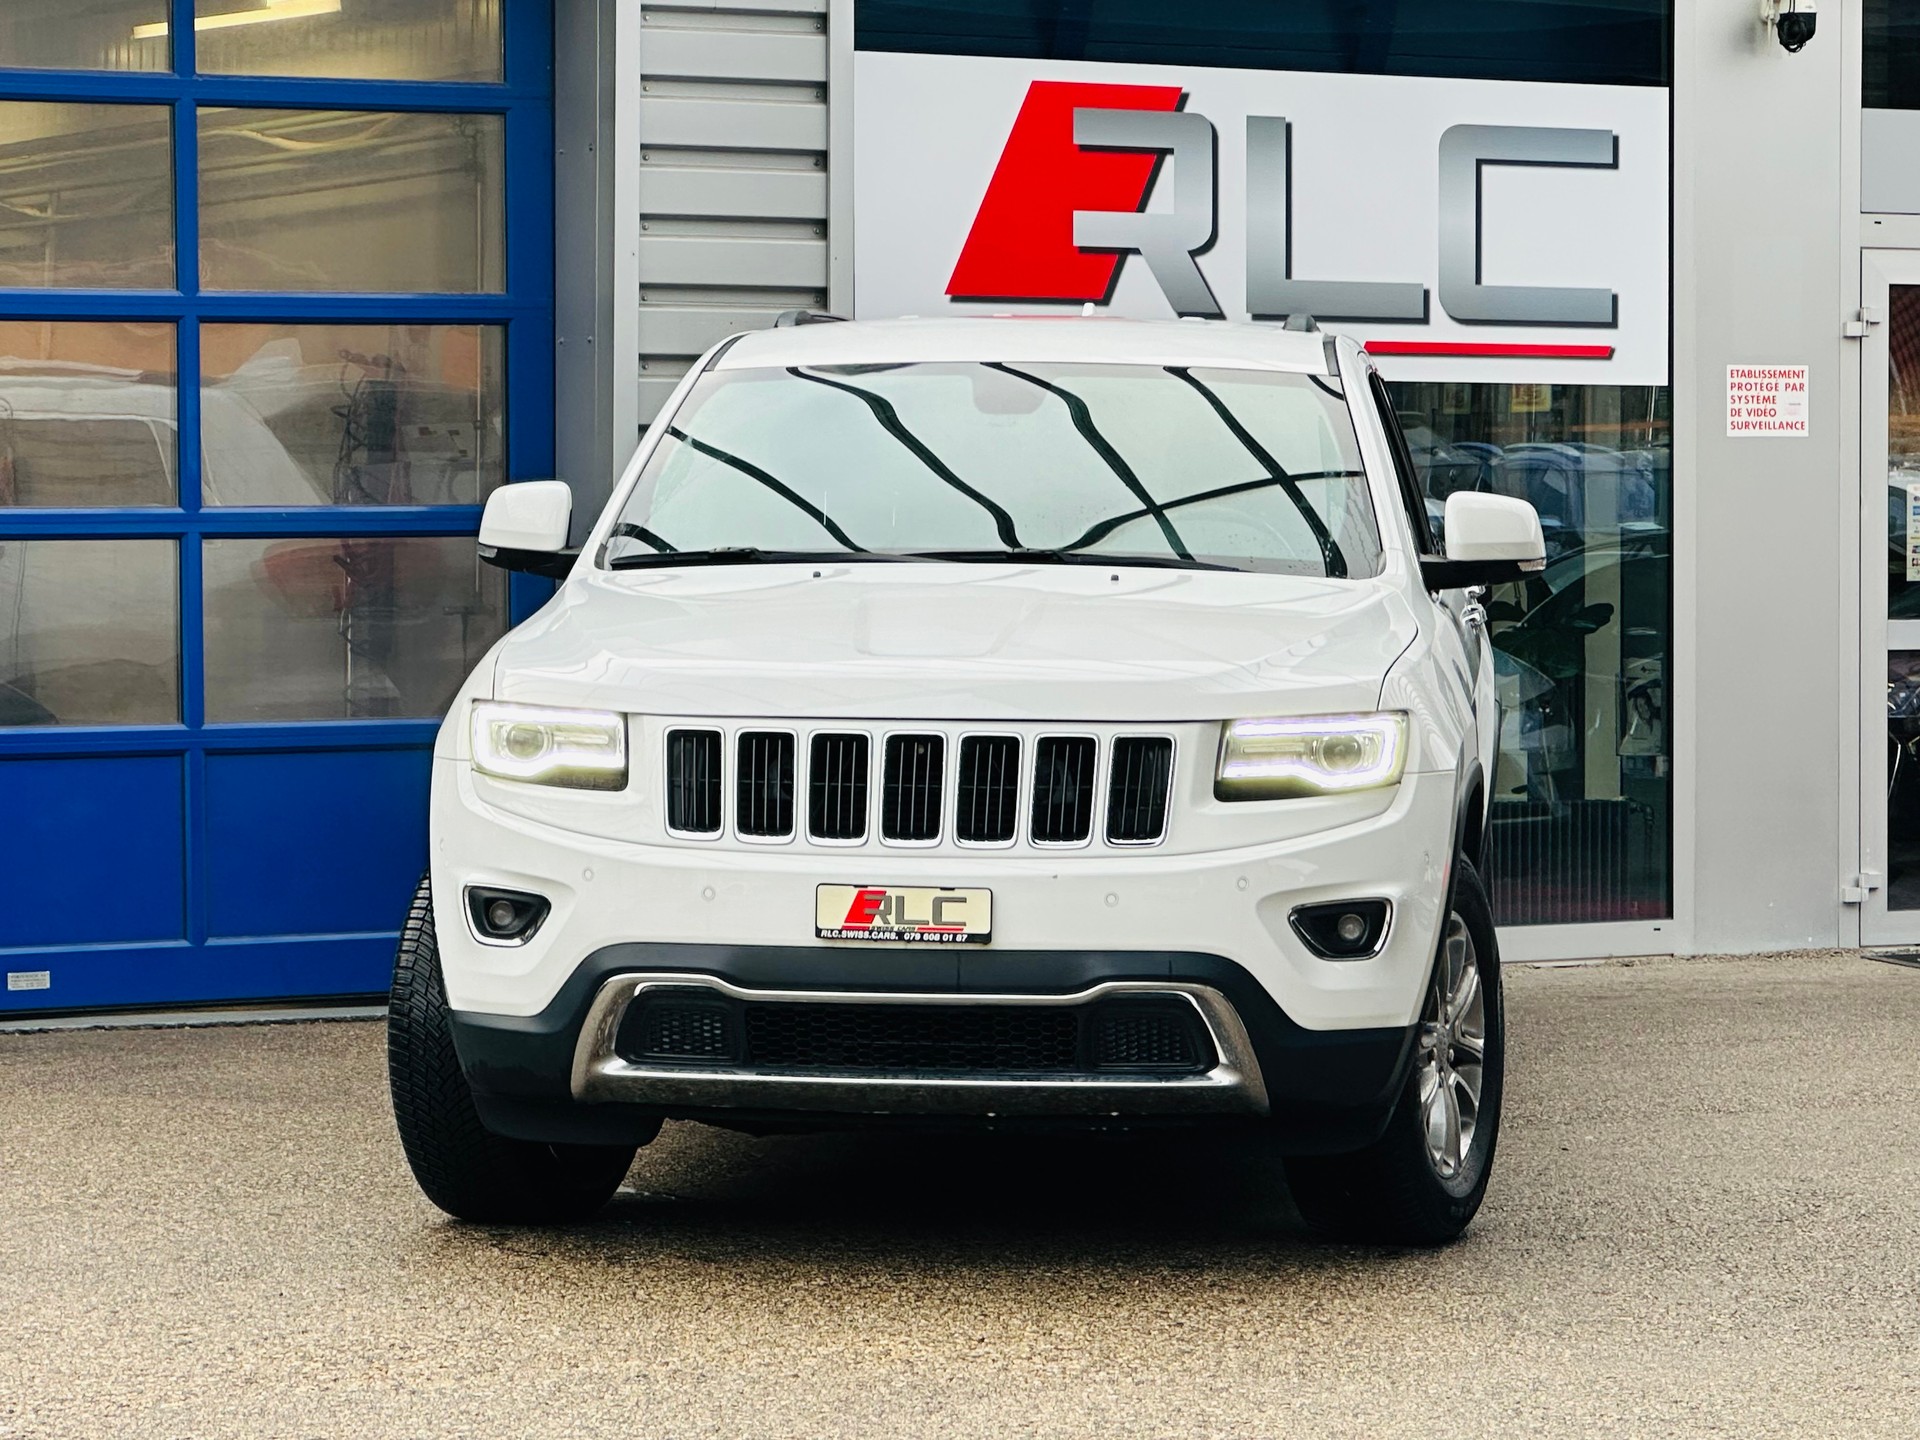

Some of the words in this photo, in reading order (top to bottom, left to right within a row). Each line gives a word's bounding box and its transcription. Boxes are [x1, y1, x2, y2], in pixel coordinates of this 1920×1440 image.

[1730, 369, 1805, 379] ETABLISSEMENT
[1784, 382, 1805, 392] PAR
[1730, 408, 1742, 417] DE
[1730, 421, 1805, 431] SURVEILLANCE
[942, 934, 954, 942] 01
